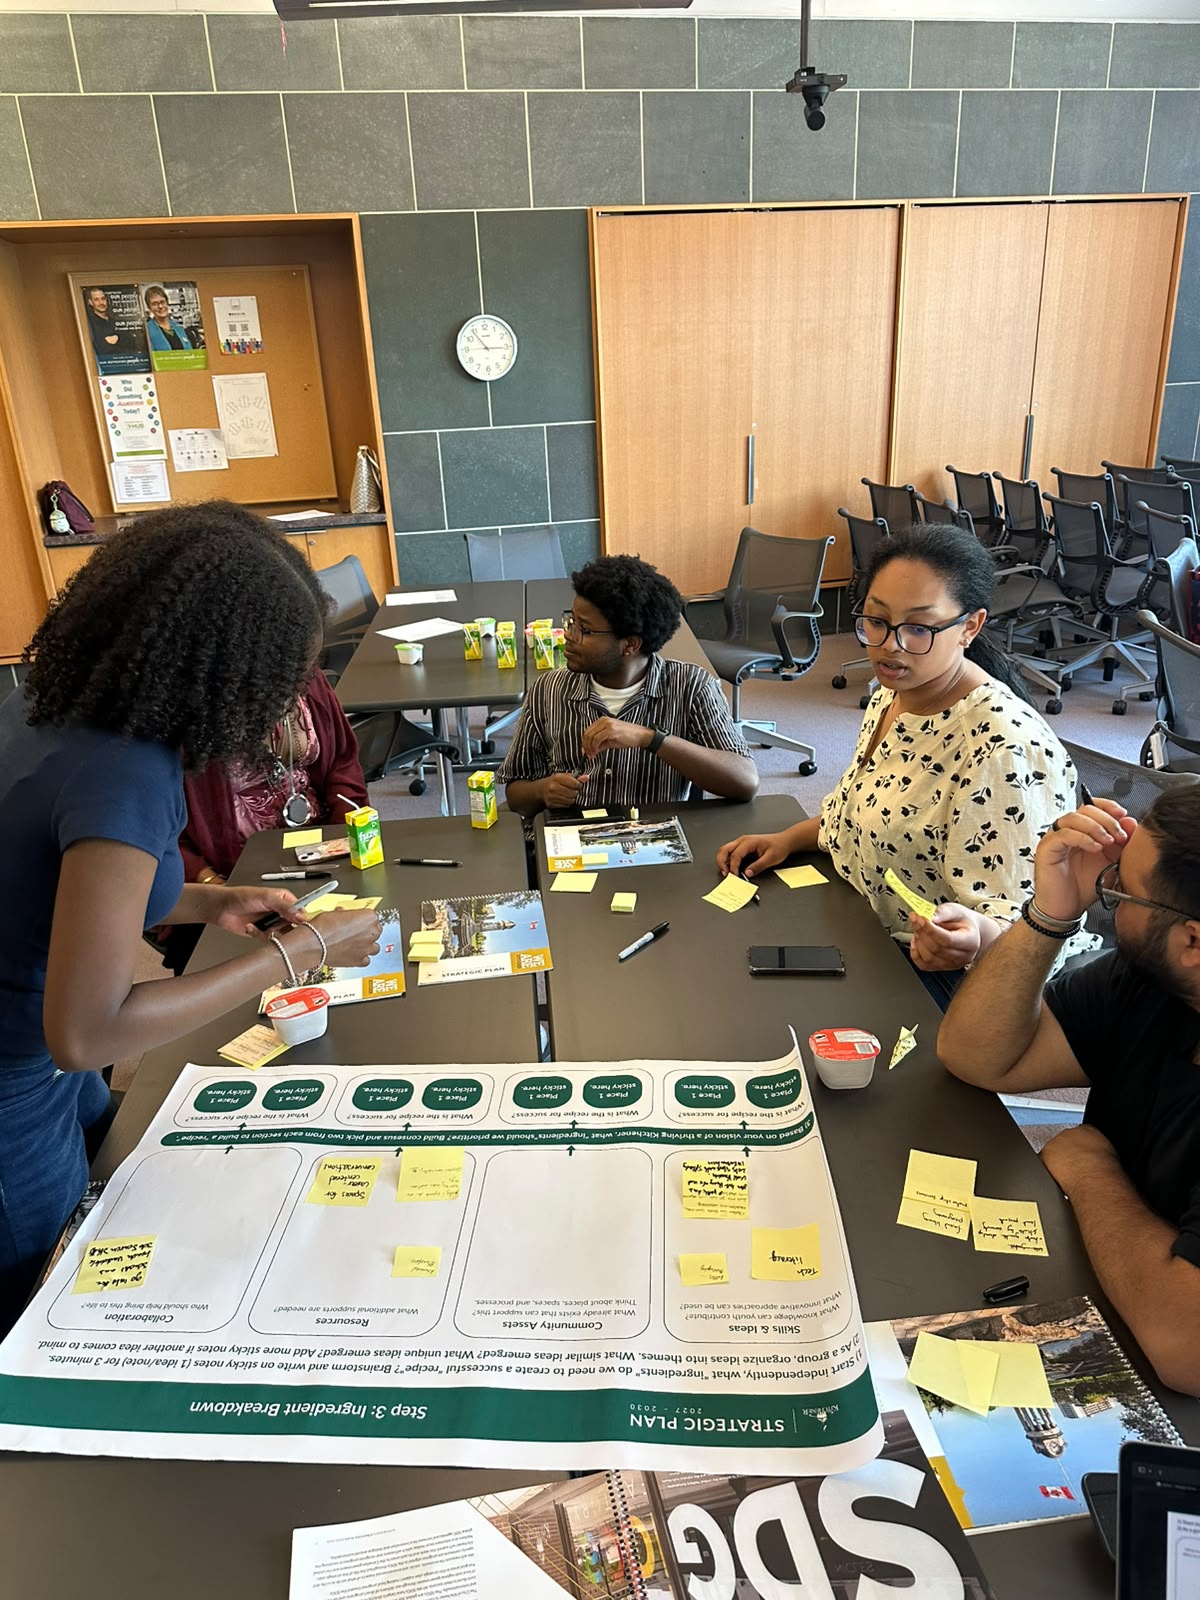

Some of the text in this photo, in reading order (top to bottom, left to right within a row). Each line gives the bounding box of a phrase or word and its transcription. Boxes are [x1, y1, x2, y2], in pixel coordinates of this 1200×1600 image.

[441, 968, 483, 977] STRATEGIC
[804, 1119, 810, 1128] 3)
[304, 1131, 325, 1139] from
[614, 1130, 658, 1138] Kitchener,
[661, 1131, 694, 1140] thriving
[778, 1125, 804, 1139] Based
[345, 1133, 364, 1141] pick
[769, 1251, 803, 1265] literacy
[797, 1268, 818, 1276] Tech
[822, 1290, 841, 1304] What
[779, 1300, 821, 1310] innovative
[818, 1303, 840, 1316] What
[582, 1309, 611, 1317] already
[731, 1312, 756, 1320] youth
[773, 1311, 817, 1320] knowldege
[104, 1313, 173, 1323] Collaboration
[315, 1317, 369, 1327] Resources
[502, 1320, 602, 1330] Community Assets
[728, 1325, 800, 1333] Skills & Ideas
[852, 1332, 859, 1346] 2)
[37, 1340, 67, 1349] mind.
[118, 1343, 141, 1352] idea
[143, 1343, 185, 1353] another
[186, 1344, 195, 1353] if
[196, 1345, 227, 1353] notes
[840, 1340, 851, 1353] As
[228, 1344, 260, 1355] sticky
[263, 1347, 291, 1355] more
[293, 1348, 316, 1357] Add
[318, 1348, 370, 1358] emerged?
[373, 1349, 401, 1358] ideas
[404, 1348, 441, 1359] unique
[476, 1349, 531, 1359] emerged?
[444, 1350, 474, 1359] What
[534, 1352, 562, 1362] ideas
[564, 1352, 601, 1362] similar
[604, 1351, 635, 1360] What
[638, 1352, 682, 1364] themes.
[793, 1350, 829, 1363] group,
[855, 1348, 861, 1361] 1)
[48, 1355, 93, 1365] minutes.
[93, 1357, 102, 1366] 3
[103, 1357, 120, 1366] for
[121, 1356, 178, 1368] idea/note)
[180, 1358, 191, 1368] (1
[193, 1360, 224, 1368] notes
[685, 1355, 707, 1364] into
[710, 1355, 740, 1365] ideas
[742, 1354, 791, 1365] organize
[225, 1359, 258, 1370] sticky
[276, 1362, 305, 1371] write
[307, 1363, 329, 1372] and
[331, 1363, 392, 1373] Brainstorm
[445, 1364, 502, 1374] successful
[831, 1357, 855, 1374] Start
[514, 1366, 550, 1374] create
[552, 1367, 564, 1376] to
[567, 1367, 595, 1376] need
[617, 1366, 632, 1375] do
[712, 1370, 740, 1379] what
[743, 1367, 828, 1380] independently,
[189, 1401, 427, 1419] Step 3: Ingredient Breakdown
[629, 1403, 656, 1412] 2030
[630, 1413, 784, 1432] STRATEGIC PLAN
